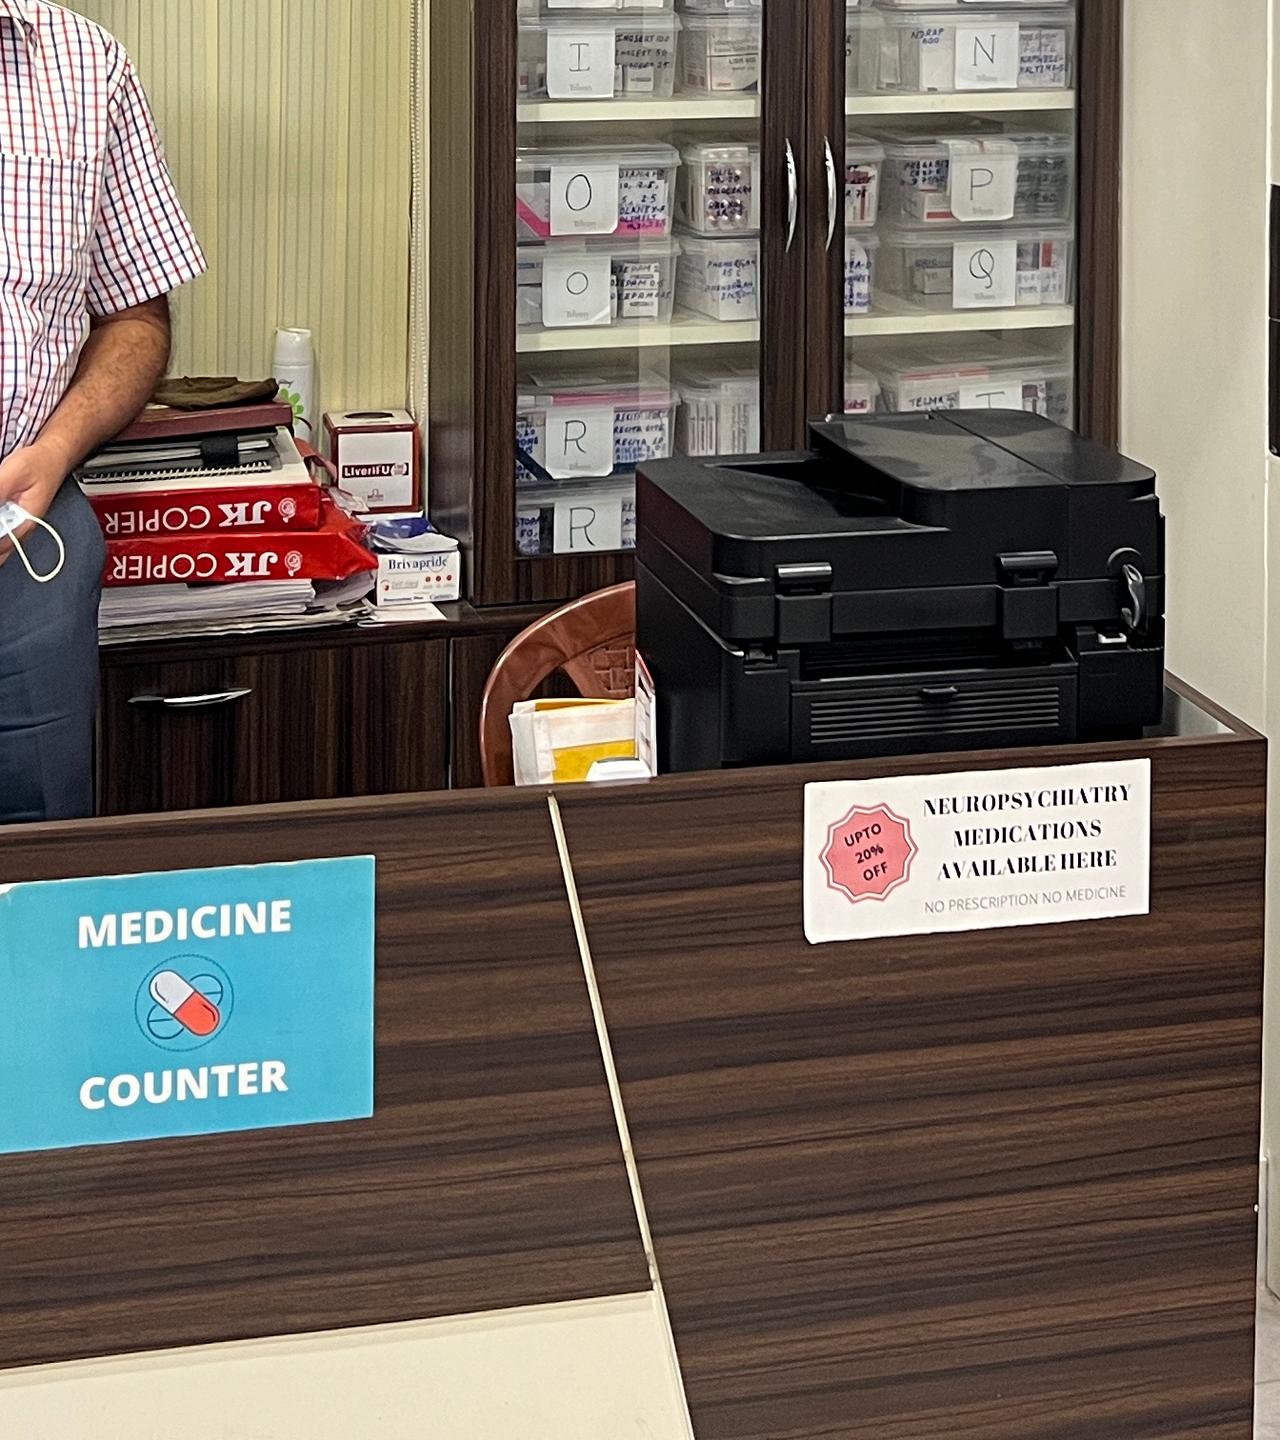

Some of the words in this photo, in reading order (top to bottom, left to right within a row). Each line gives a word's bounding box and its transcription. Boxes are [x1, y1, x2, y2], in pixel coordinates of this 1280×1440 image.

[569, 42, 590, 72] I
[971, 33, 996, 67] N
[970, 168, 994, 200] P
[969, 248, 995, 289] Q
[564, 419, 587, 456] R
[105, 505, 211, 535] COPIER
[219, 500, 272, 528] JK
[569, 506, 596, 549] R
[111, 553, 217, 580] COPIER
[224, 551, 278, 578] JK
[923, 783, 1132, 817] NEUROPSYCHIATRY
[844, 822, 883, 848] UPTO
[953, 819, 1102, 848] MEDICATIONS
[855, 842, 885, 864] 20%
[937, 854, 1056, 881] AVAILABLE
[1059, 849, 1118, 871] HERE
[863, 861, 889, 883] OFF
[924, 900, 945, 914] NO
[948, 892, 1038, 912] PRESCRIPTION
[1042, 891, 1063, 905] NO
[1065, 885, 1127, 903] MEDICINE
[77, 899, 292, 949] MEDICINE
[79, 1060, 289, 1110] COUNTER
